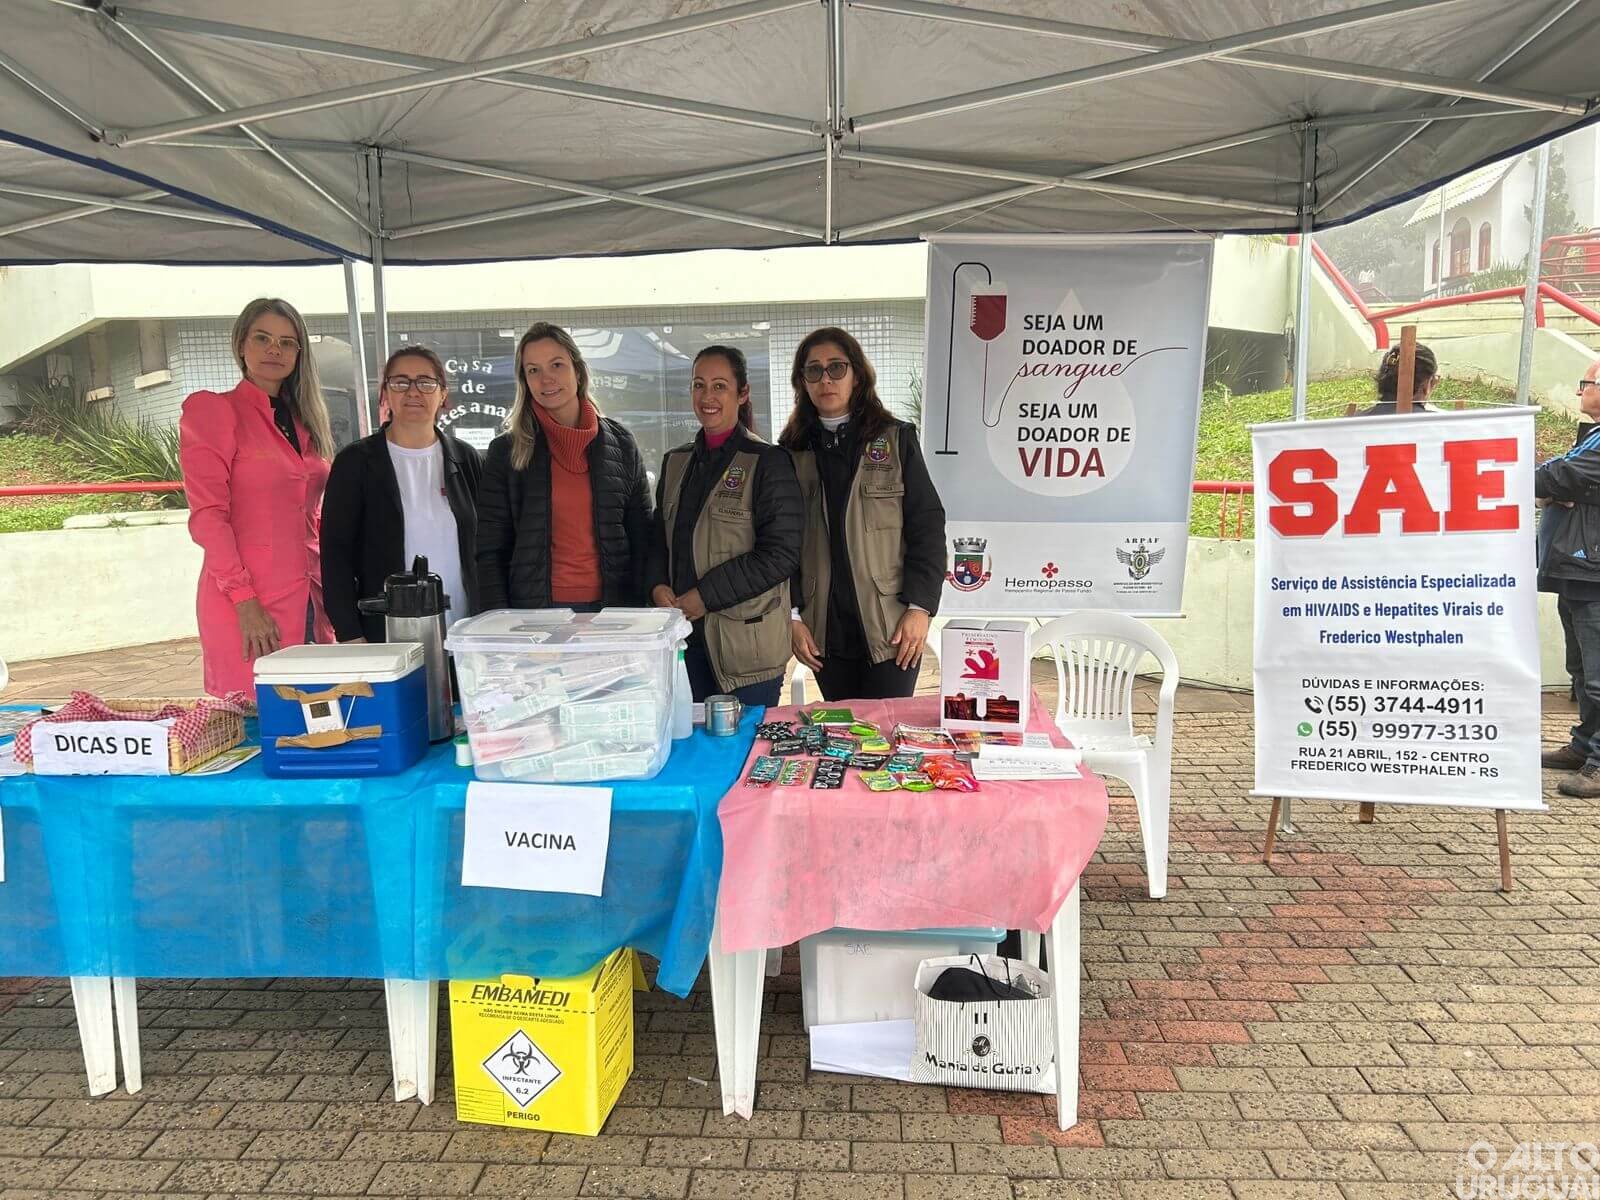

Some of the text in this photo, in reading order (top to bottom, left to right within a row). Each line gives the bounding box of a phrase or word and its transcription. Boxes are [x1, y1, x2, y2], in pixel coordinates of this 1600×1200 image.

[1023, 314, 1104, 333] SEJA UM
[1022, 339, 1138, 356] DOADOR DE
[444, 357, 494, 374] Casa
[461, 380, 486, 394] de
[1018, 361, 1122, 399] sangue
[1018, 402, 1098, 421] SEJA UM
[1017, 426, 1132, 443] DOADOR DE
[1017, 447, 1106, 478] VIDA
[1267, 437, 1521, 540] SAE
[1005, 577, 1093, 590] Hemopasso
[1271, 573, 1517, 594] Serviço de Assistência Especializada
[1282, 601, 1504, 620] em HIV/AIDS e Hepatites Virais de
[1320, 629, 1464, 647] Frederico Westphalen
[1302, 676, 1484, 693] DÚVIDAS E INFORMAÇÕES:
[1327, 695, 1484, 716] (55) 3744-4911
[1318, 719, 1498, 741] (55) 99977-3130
[55, 734, 152, 755] DICAS DE
[1299, 747, 1326, 758] RUA
[1329, 748, 1343, 758] 21
[1347, 748, 1391, 761] ABRIL,
[1395, 750, 1418, 761] 152
[1430, 751, 1489, 763] CENTRO
[1291, 759, 1367, 772] FREDERICO
[1370, 762, 1466, 777] WESTPHALEN
[1479, 767, 1499, 778] RS
[504, 831, 577, 851] VACINA
[471, 984, 571, 1007] EMBAMEDI
[925, 1051, 968, 1072] Mania
[972, 1063, 988, 1074] de
[502, 1075, 542, 1085] INFECTANTE
[515, 1086, 530, 1095] 6.2
[506, 1110, 541, 1122] PERIGO
